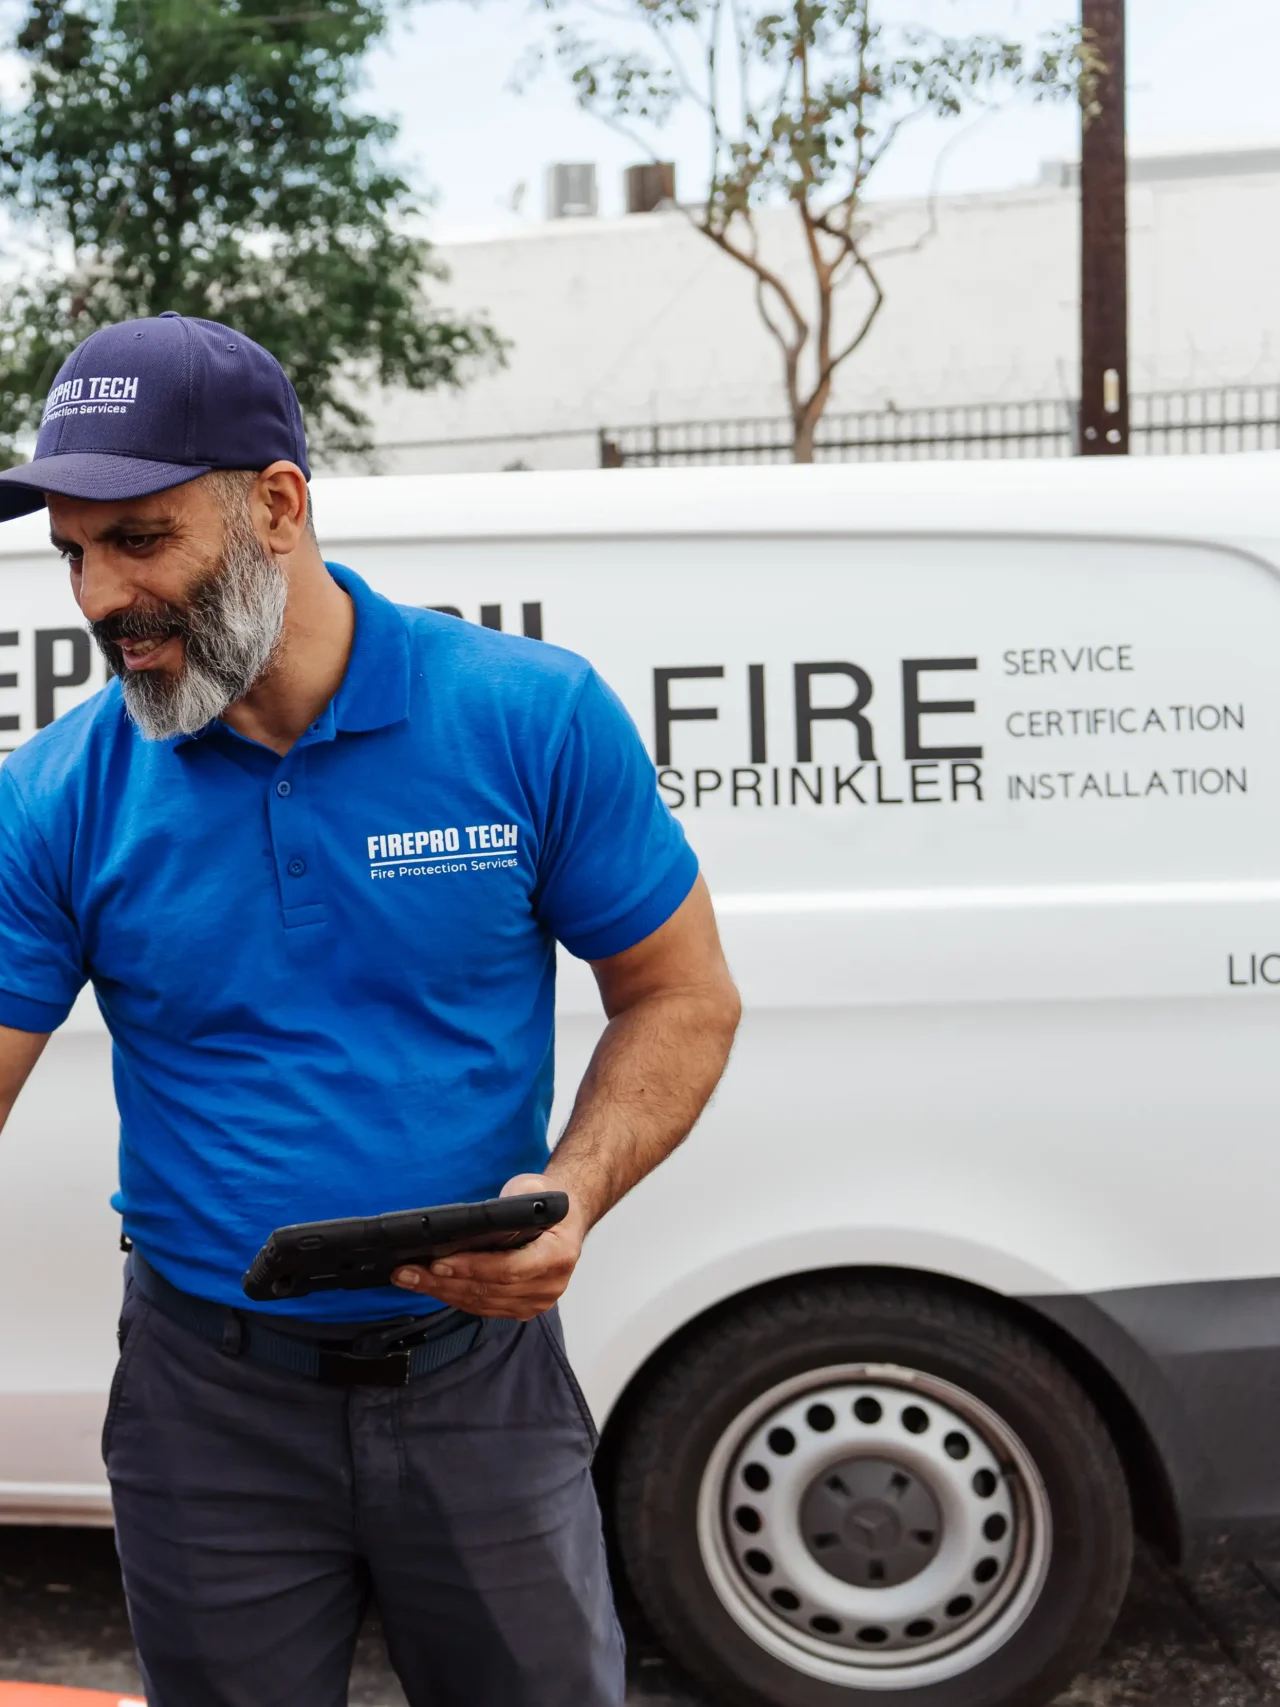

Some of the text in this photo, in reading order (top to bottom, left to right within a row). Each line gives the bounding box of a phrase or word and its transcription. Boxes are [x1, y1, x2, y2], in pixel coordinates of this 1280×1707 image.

[89, 376, 139, 398] TECH
[79, 403, 127, 415] Services
[1004, 646, 1133, 675] SERVICE
[653, 657, 983, 768] FIRE
[1006, 703, 1244, 738] CERTIFICATION
[658, 763, 983, 810] SPRINKLER
[1008, 767, 1247, 800] INSTALLATION
[367, 824, 518, 859] FIREPRO TECH
[371, 857, 518, 880] Fire Protection Services
